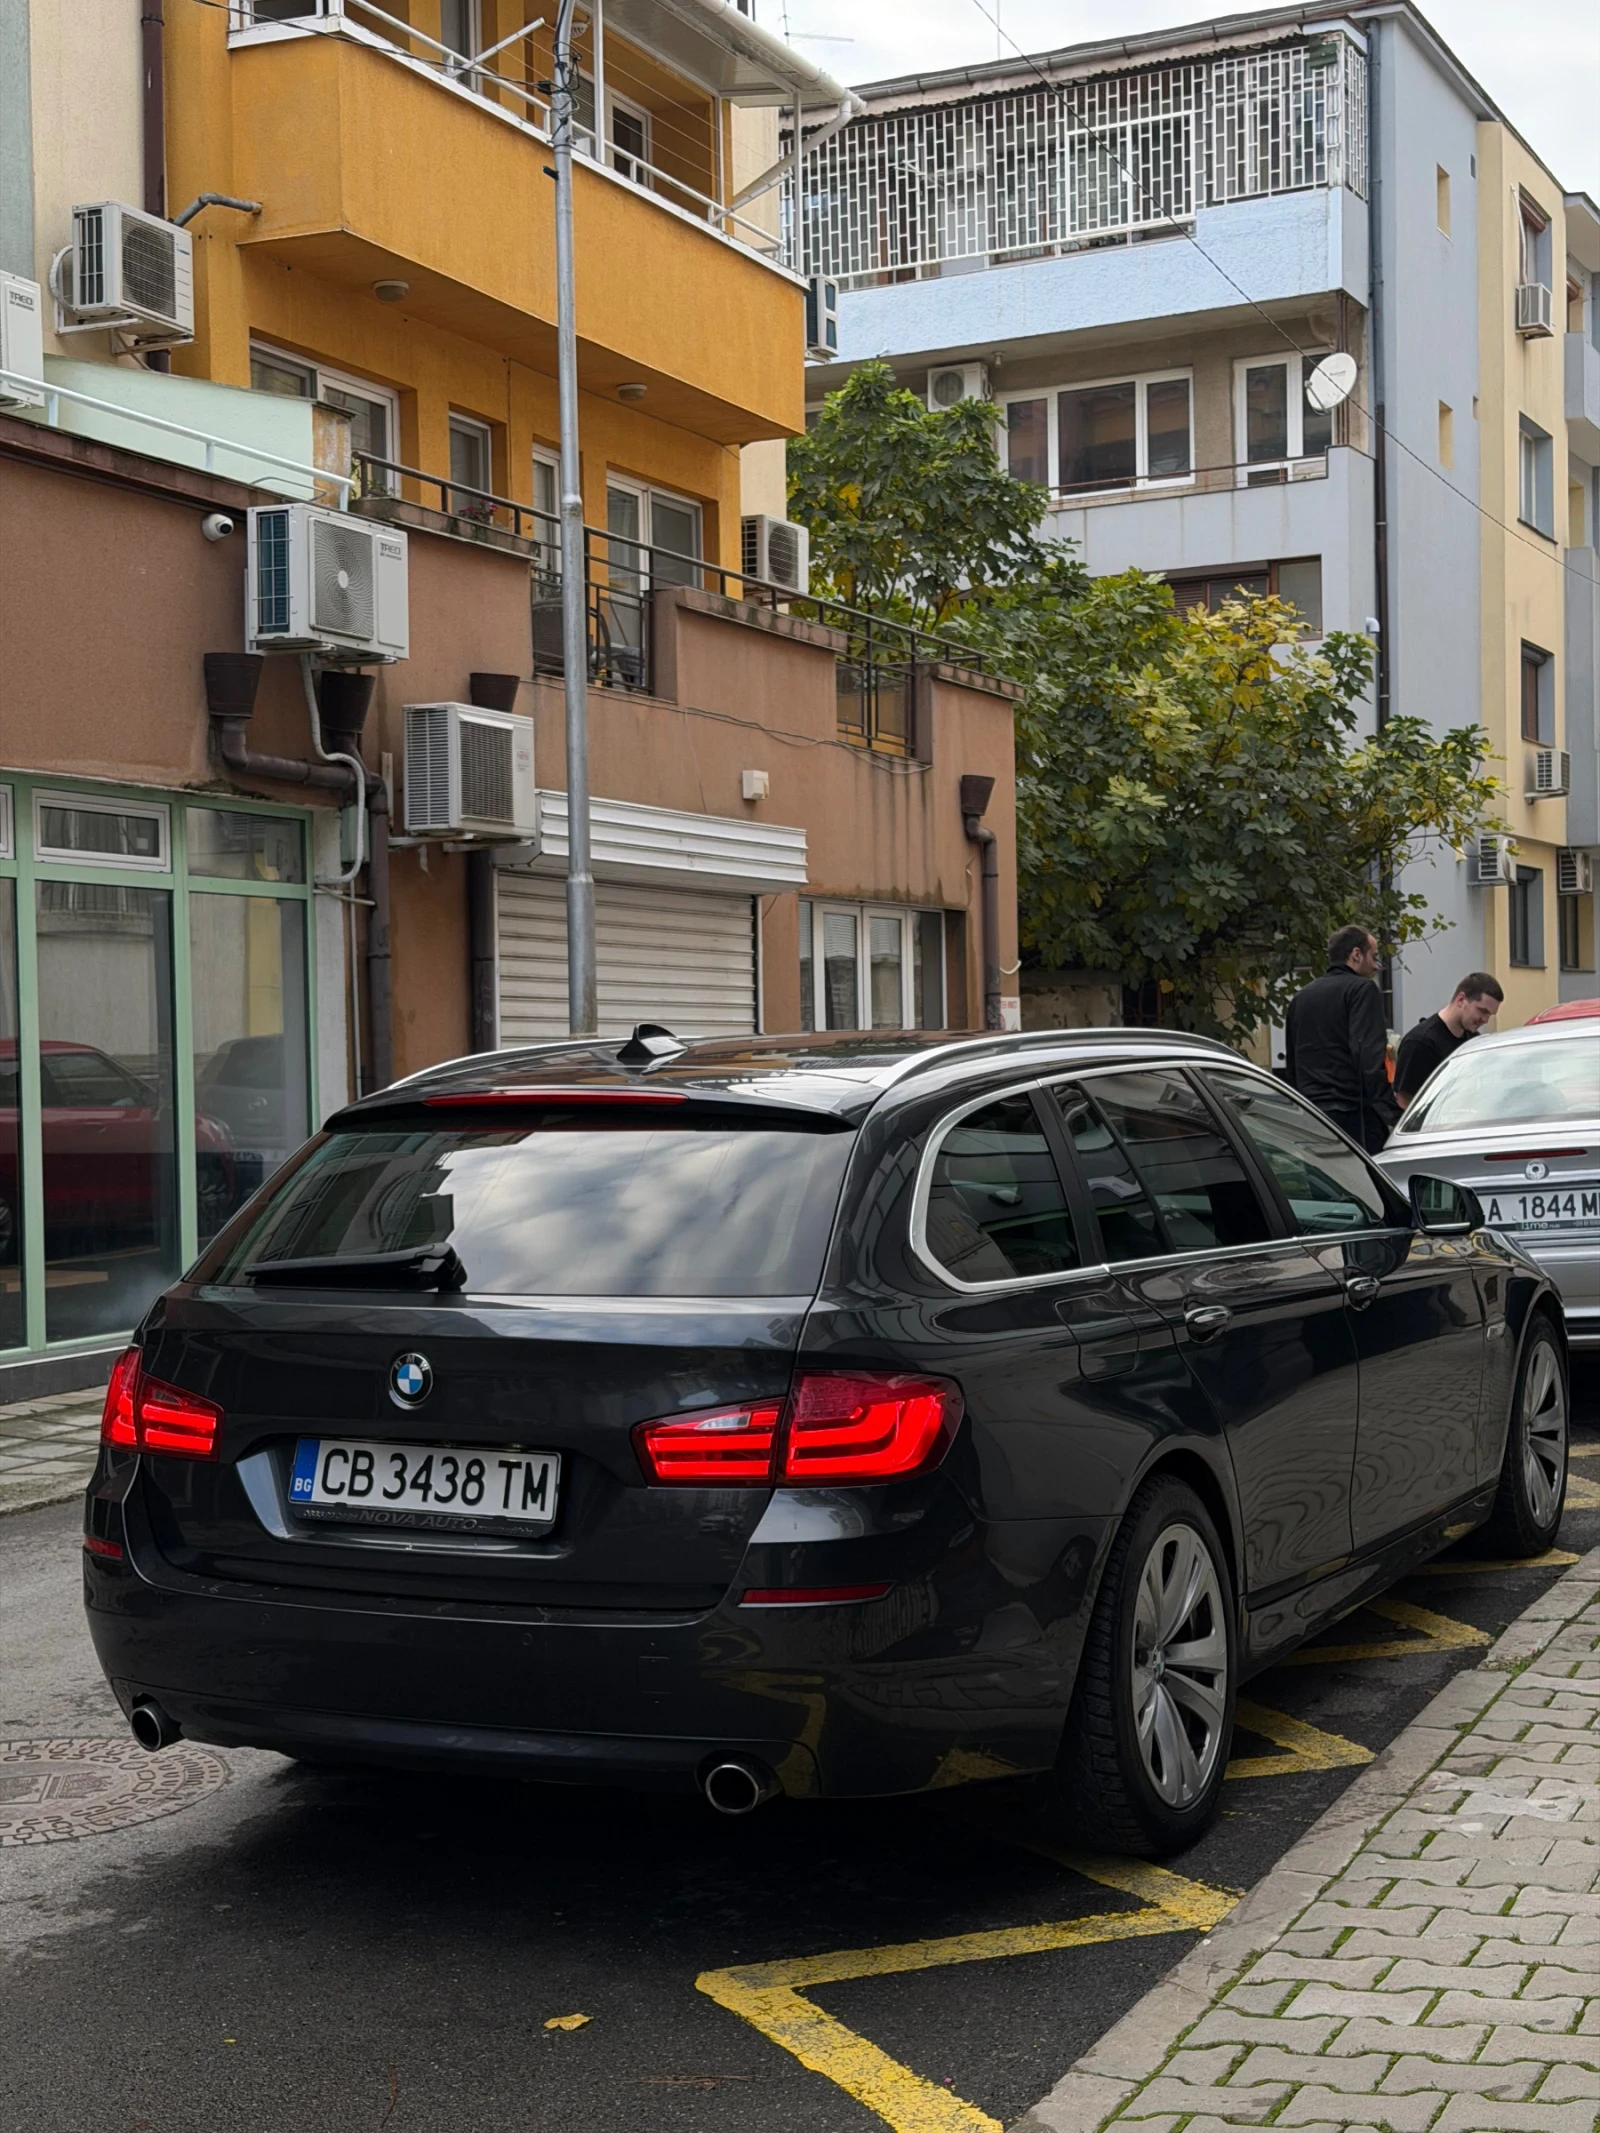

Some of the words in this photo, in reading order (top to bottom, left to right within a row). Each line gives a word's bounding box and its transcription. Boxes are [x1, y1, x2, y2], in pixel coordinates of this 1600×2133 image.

[1487, 1197, 1503, 1222] A
[1518, 1193, 1577, 1220] 1844
[1581, 1191, 1600, 1218] M
[294, 1477, 313, 1493] BG
[321, 1448, 375, 1497] CB
[382, 1452, 486, 1507] 3438
[498, 1459, 549, 1512] TM
[360, 1509, 416, 1525] NOVA
[420, 1515, 478, 1530] AUTO
